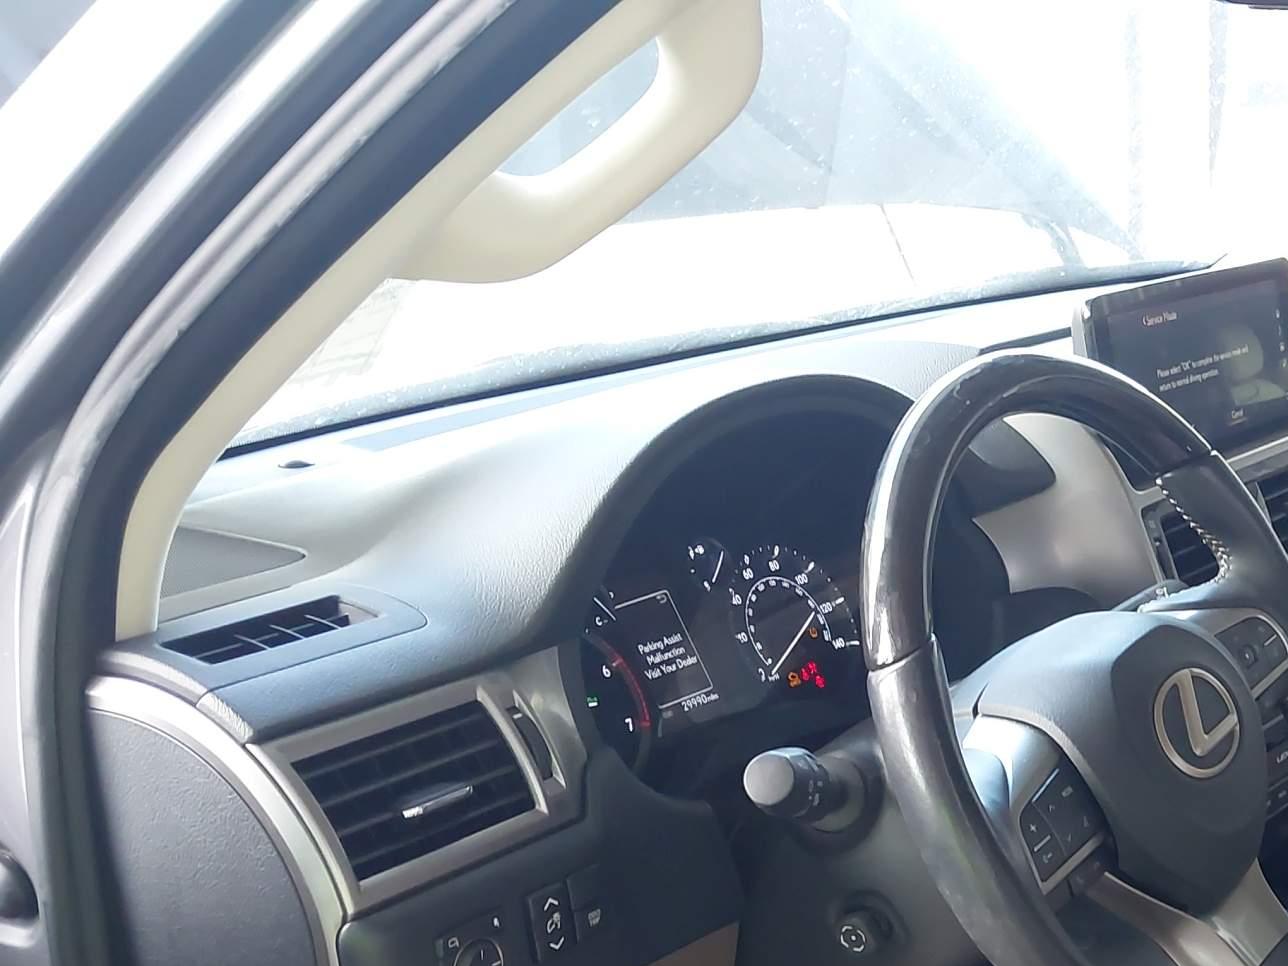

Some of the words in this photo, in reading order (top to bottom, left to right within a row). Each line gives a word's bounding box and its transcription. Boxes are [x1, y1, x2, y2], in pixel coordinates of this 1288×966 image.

[637, 640, 664, 655] Parking
[663, 633, 683, 646] Assist
[646, 647, 686, 666] Malfunction
[602, 664, 611, 678] 6
[644, 667, 662, 680] Visit
[659, 662, 677, 675] Your
[675, 655, 698, 669] Dealer
[624, 717, 633, 732] 7
